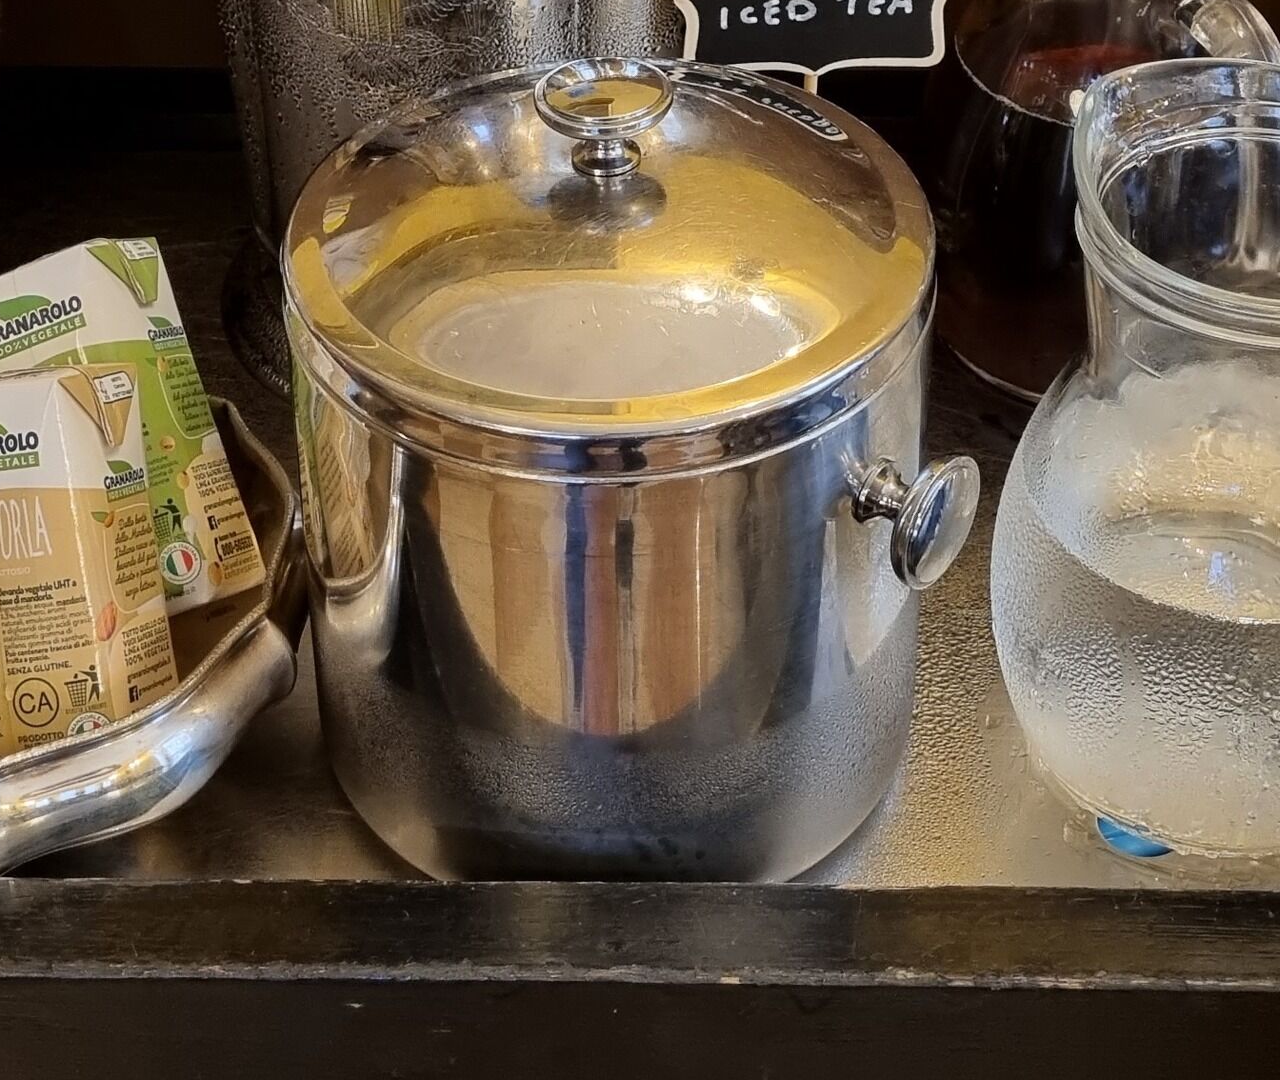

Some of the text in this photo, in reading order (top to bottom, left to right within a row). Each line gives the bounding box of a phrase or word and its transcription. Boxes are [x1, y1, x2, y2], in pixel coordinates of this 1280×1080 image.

[53, 579, 71, 590] UHT
[6, 660, 73, 676] SENZA GLUTINE.
[18, 691, 54, 715] CA
[17, 731, 65, 744] PRODOTTO
